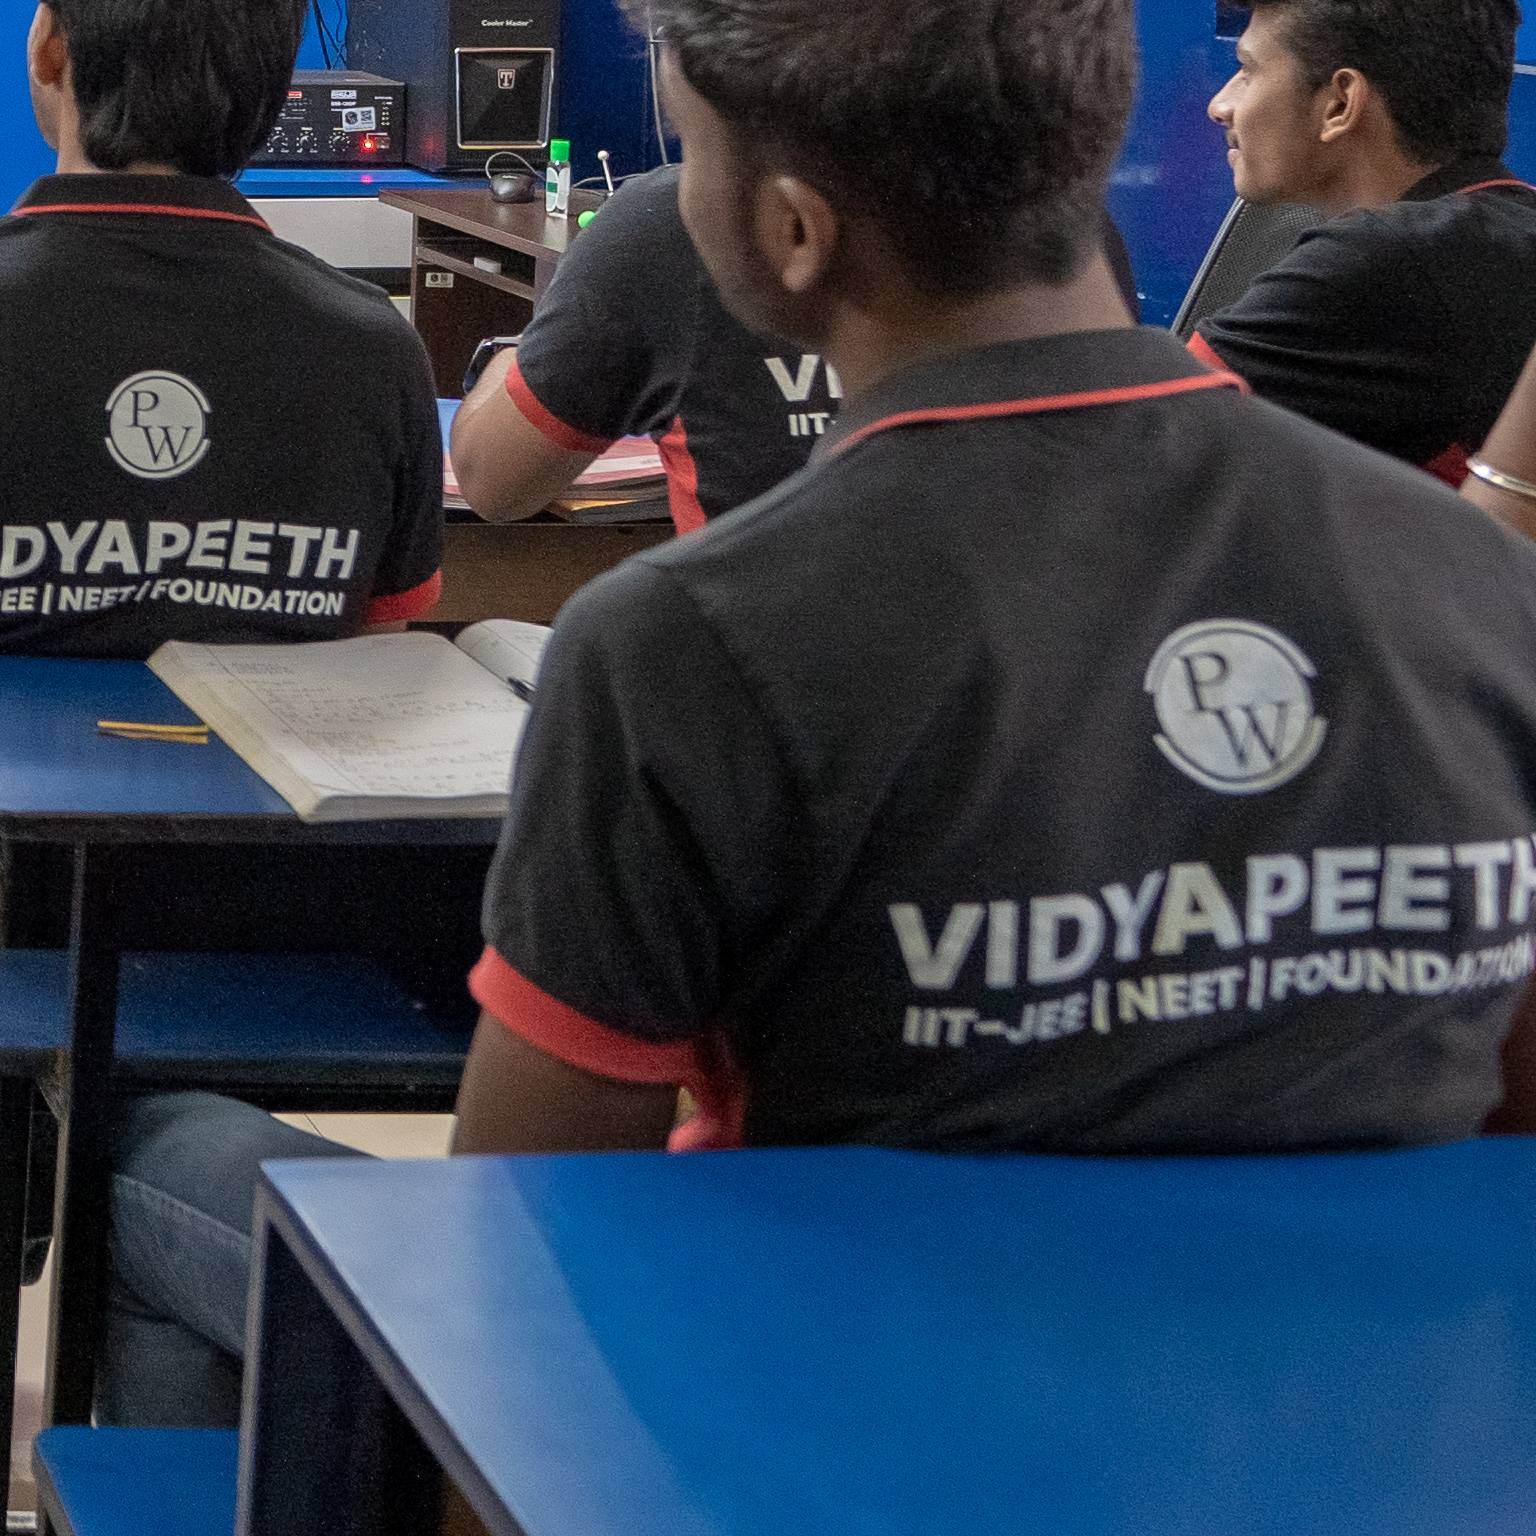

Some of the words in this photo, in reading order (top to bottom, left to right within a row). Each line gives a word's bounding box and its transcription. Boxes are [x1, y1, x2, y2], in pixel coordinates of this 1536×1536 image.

[129, 390, 193, 465] PW
[58, 584, 136, 614] NEET
[149, 577, 345, 616] FOUNDATION
[1178, 650, 1289, 767] PW
[1117, 967, 1245, 1024] NEET
